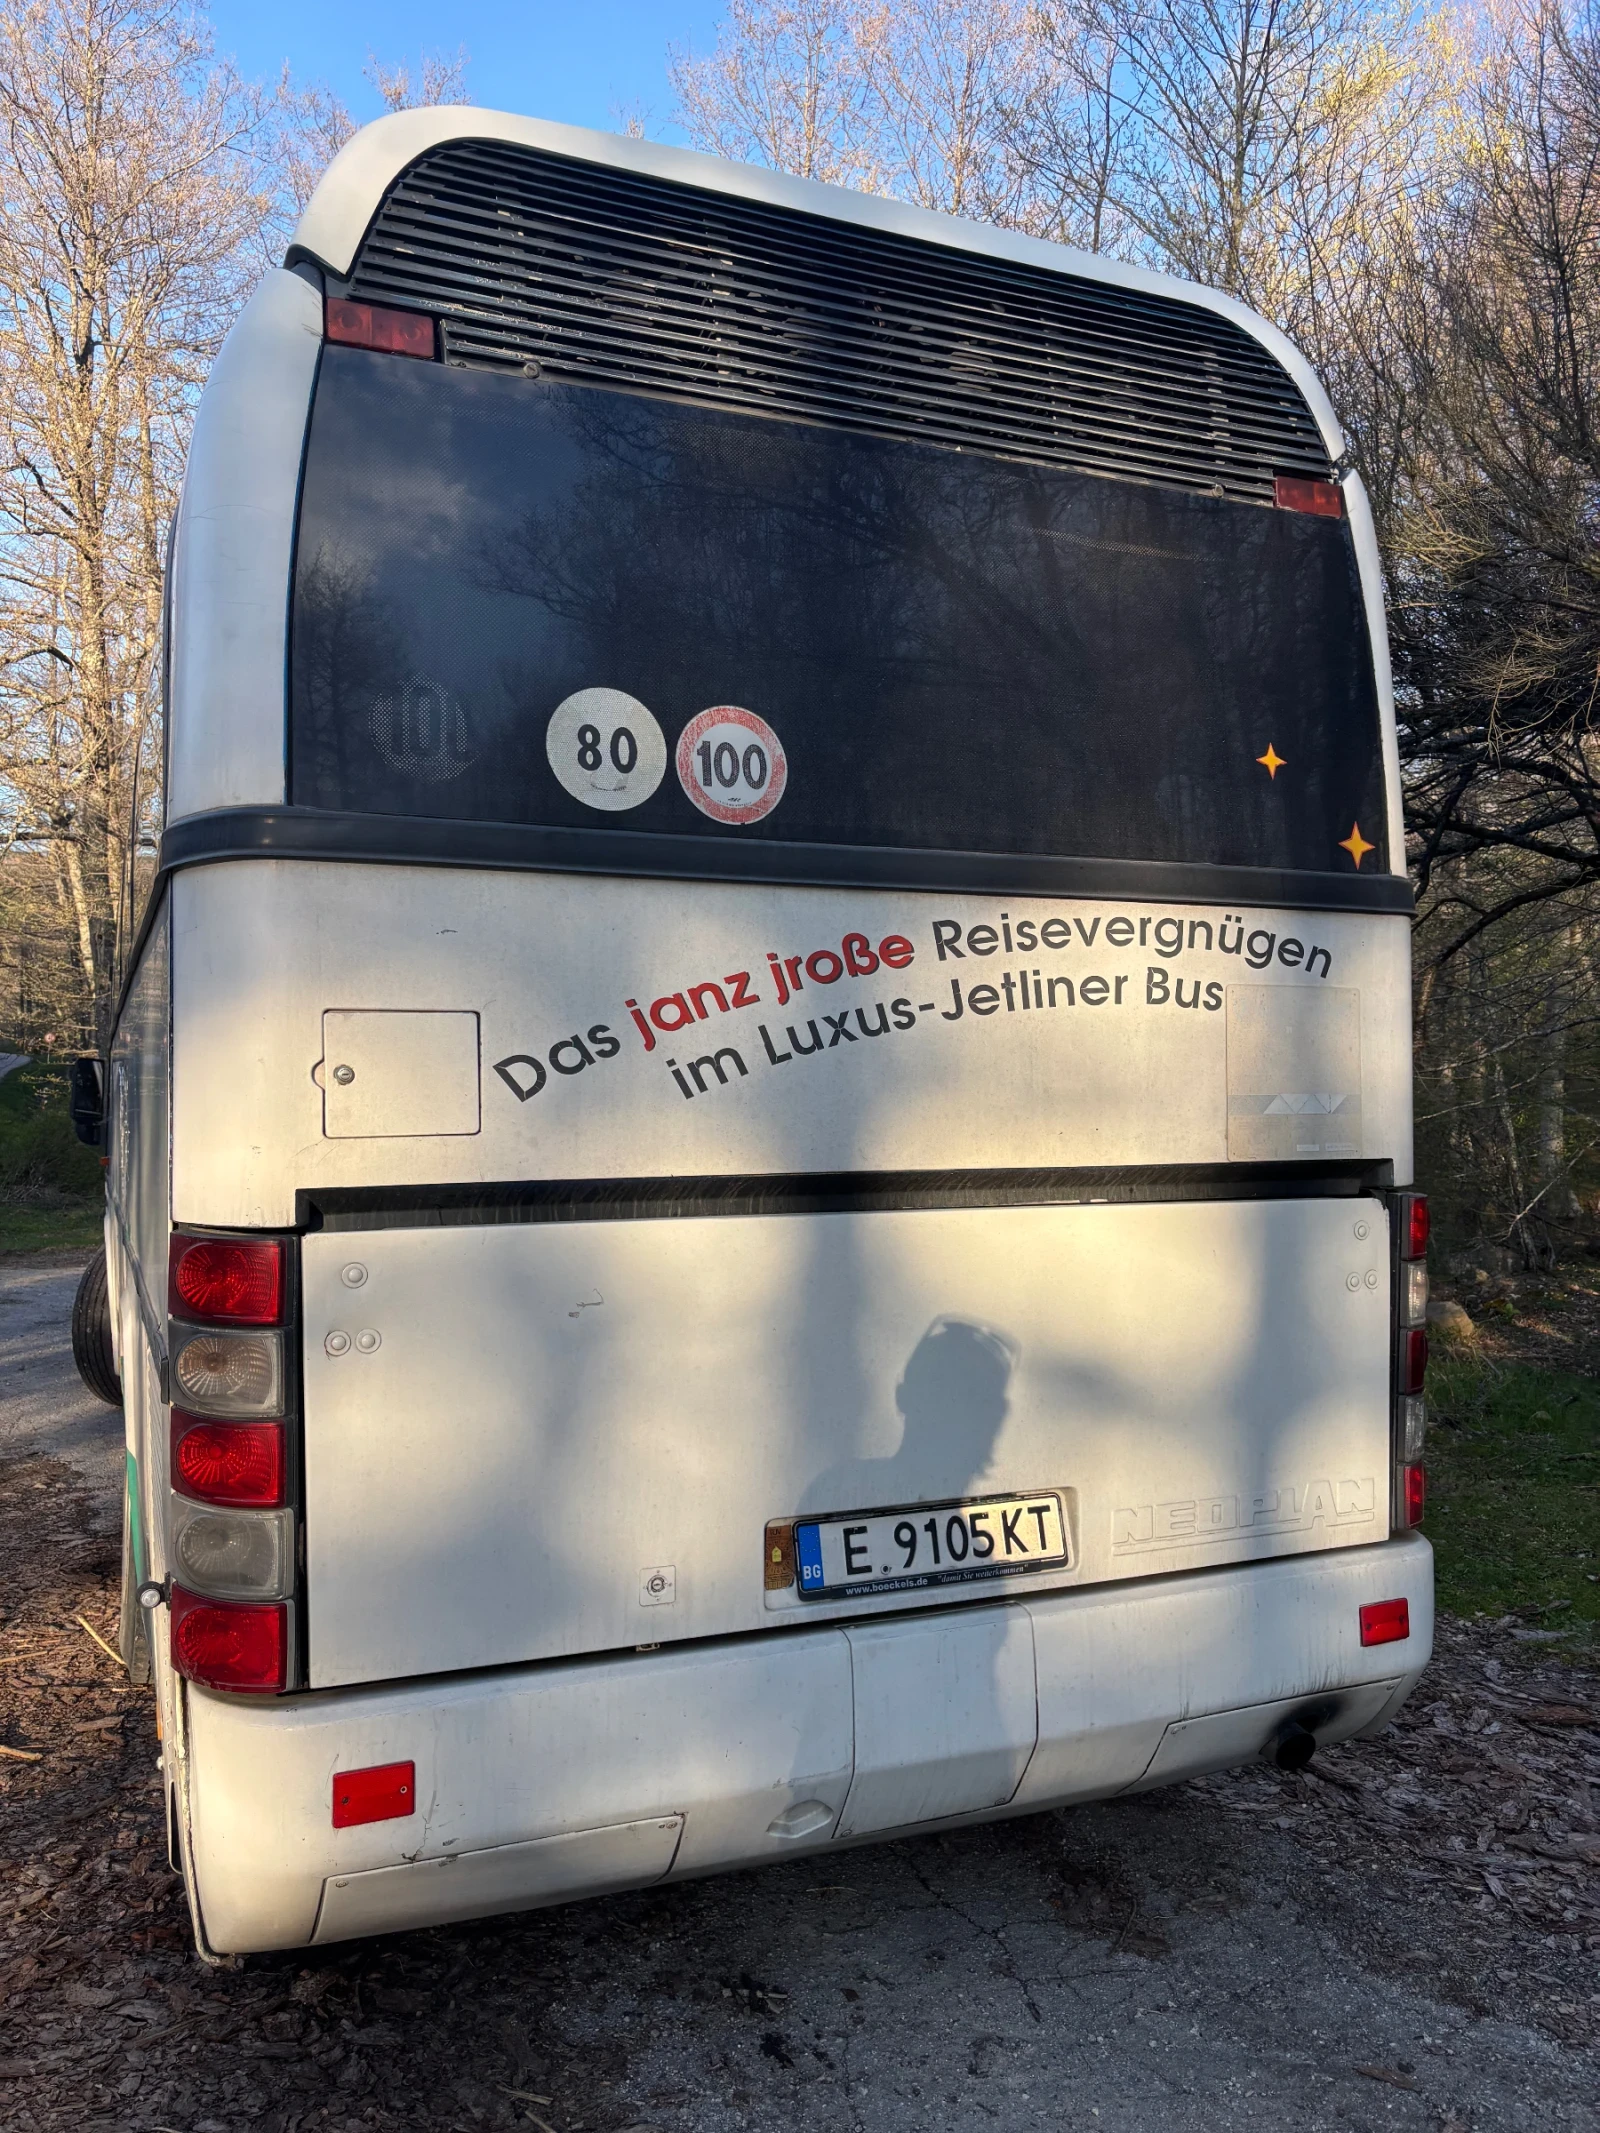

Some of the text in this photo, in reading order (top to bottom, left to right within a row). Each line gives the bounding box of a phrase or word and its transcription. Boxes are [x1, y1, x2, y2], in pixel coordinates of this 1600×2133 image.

[577, 724, 638, 774] 80
[697, 740, 767, 790] 100
[492, 913, 1332, 1102] Das janz jroße Reisevergnügen
[666, 966, 1224, 1100] im Luxus-Jetliner Bus
[1111, 1477, 1376, 1545] NEOPLAN
[803, 1564, 821, 1580] BG
[845, 1577, 928, 1595] www.boeckels.de
